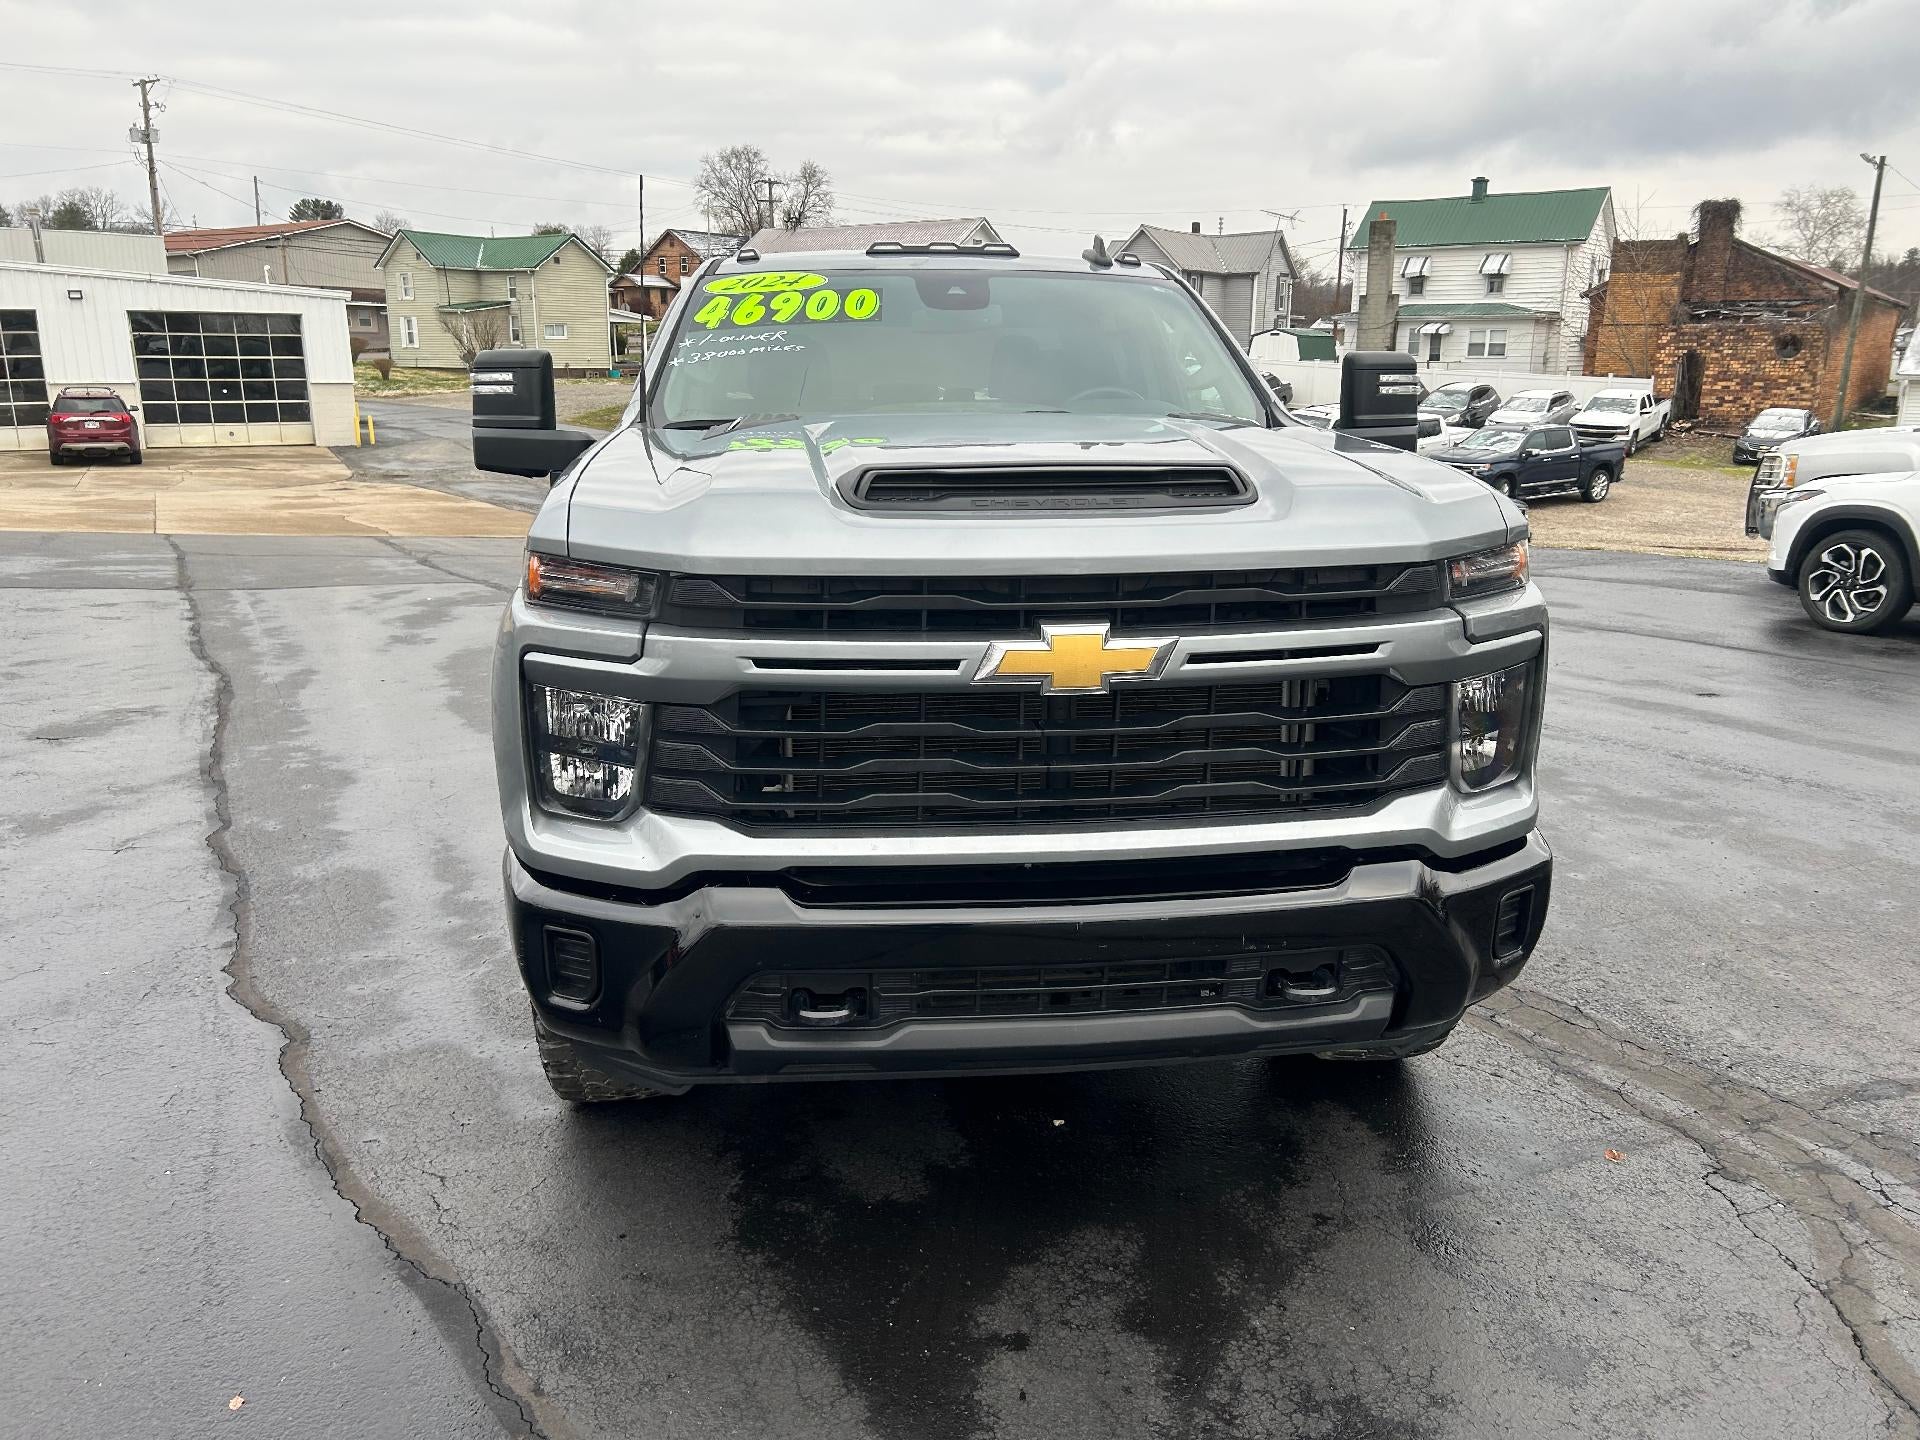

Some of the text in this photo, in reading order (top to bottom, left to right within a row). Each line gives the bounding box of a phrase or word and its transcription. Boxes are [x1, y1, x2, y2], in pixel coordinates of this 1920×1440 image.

[720, 273, 809, 290] 2024
[693, 288, 880, 329] 46900
[971, 497, 1144, 508] CHEVROLET
